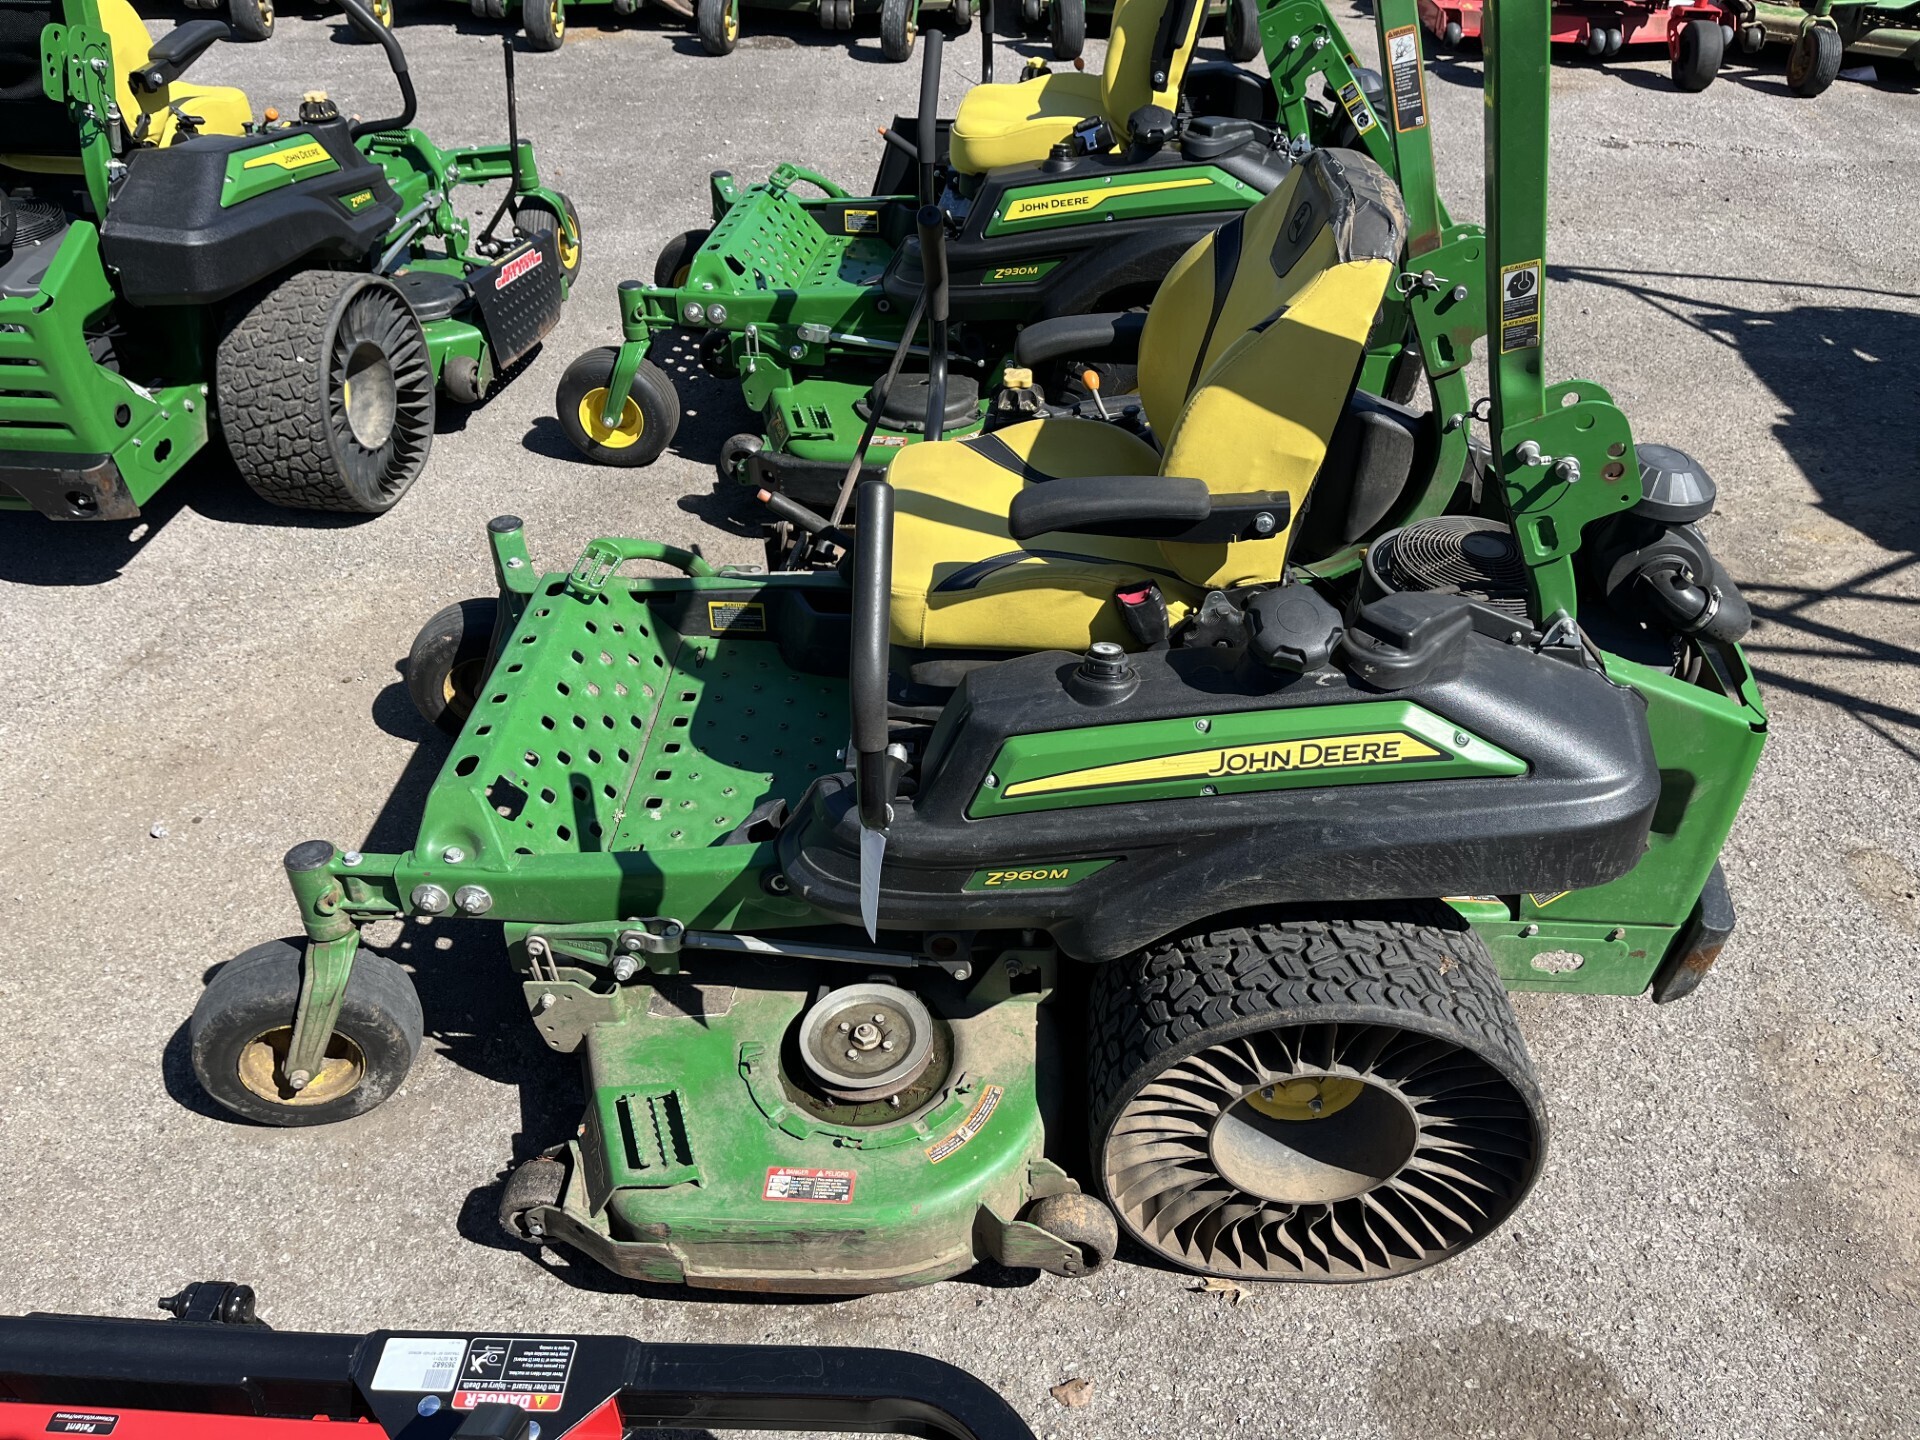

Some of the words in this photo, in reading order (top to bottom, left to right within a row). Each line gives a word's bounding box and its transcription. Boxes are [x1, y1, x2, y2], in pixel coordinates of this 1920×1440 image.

[1018, 202, 1048, 213] JOHN
[1050, 196, 1089, 208] DEERE
[1510, 261, 1538, 271] CAUTION
[993, 266, 1038, 279] Z930M
[1208, 749, 1292, 776] JOHN
[1297, 740, 1401, 768] DEERE
[984, 868, 1069, 886] Z960M
[463, 1381, 481, 1389] Death
[488, 1381, 507, 1390] Injury
[512, 1383, 533, 1391] Hazard
[533, 1383, 547, 1391] Over
[548, 1384, 561, 1392] Run
[64, 1422, 96, 1433] Patent
